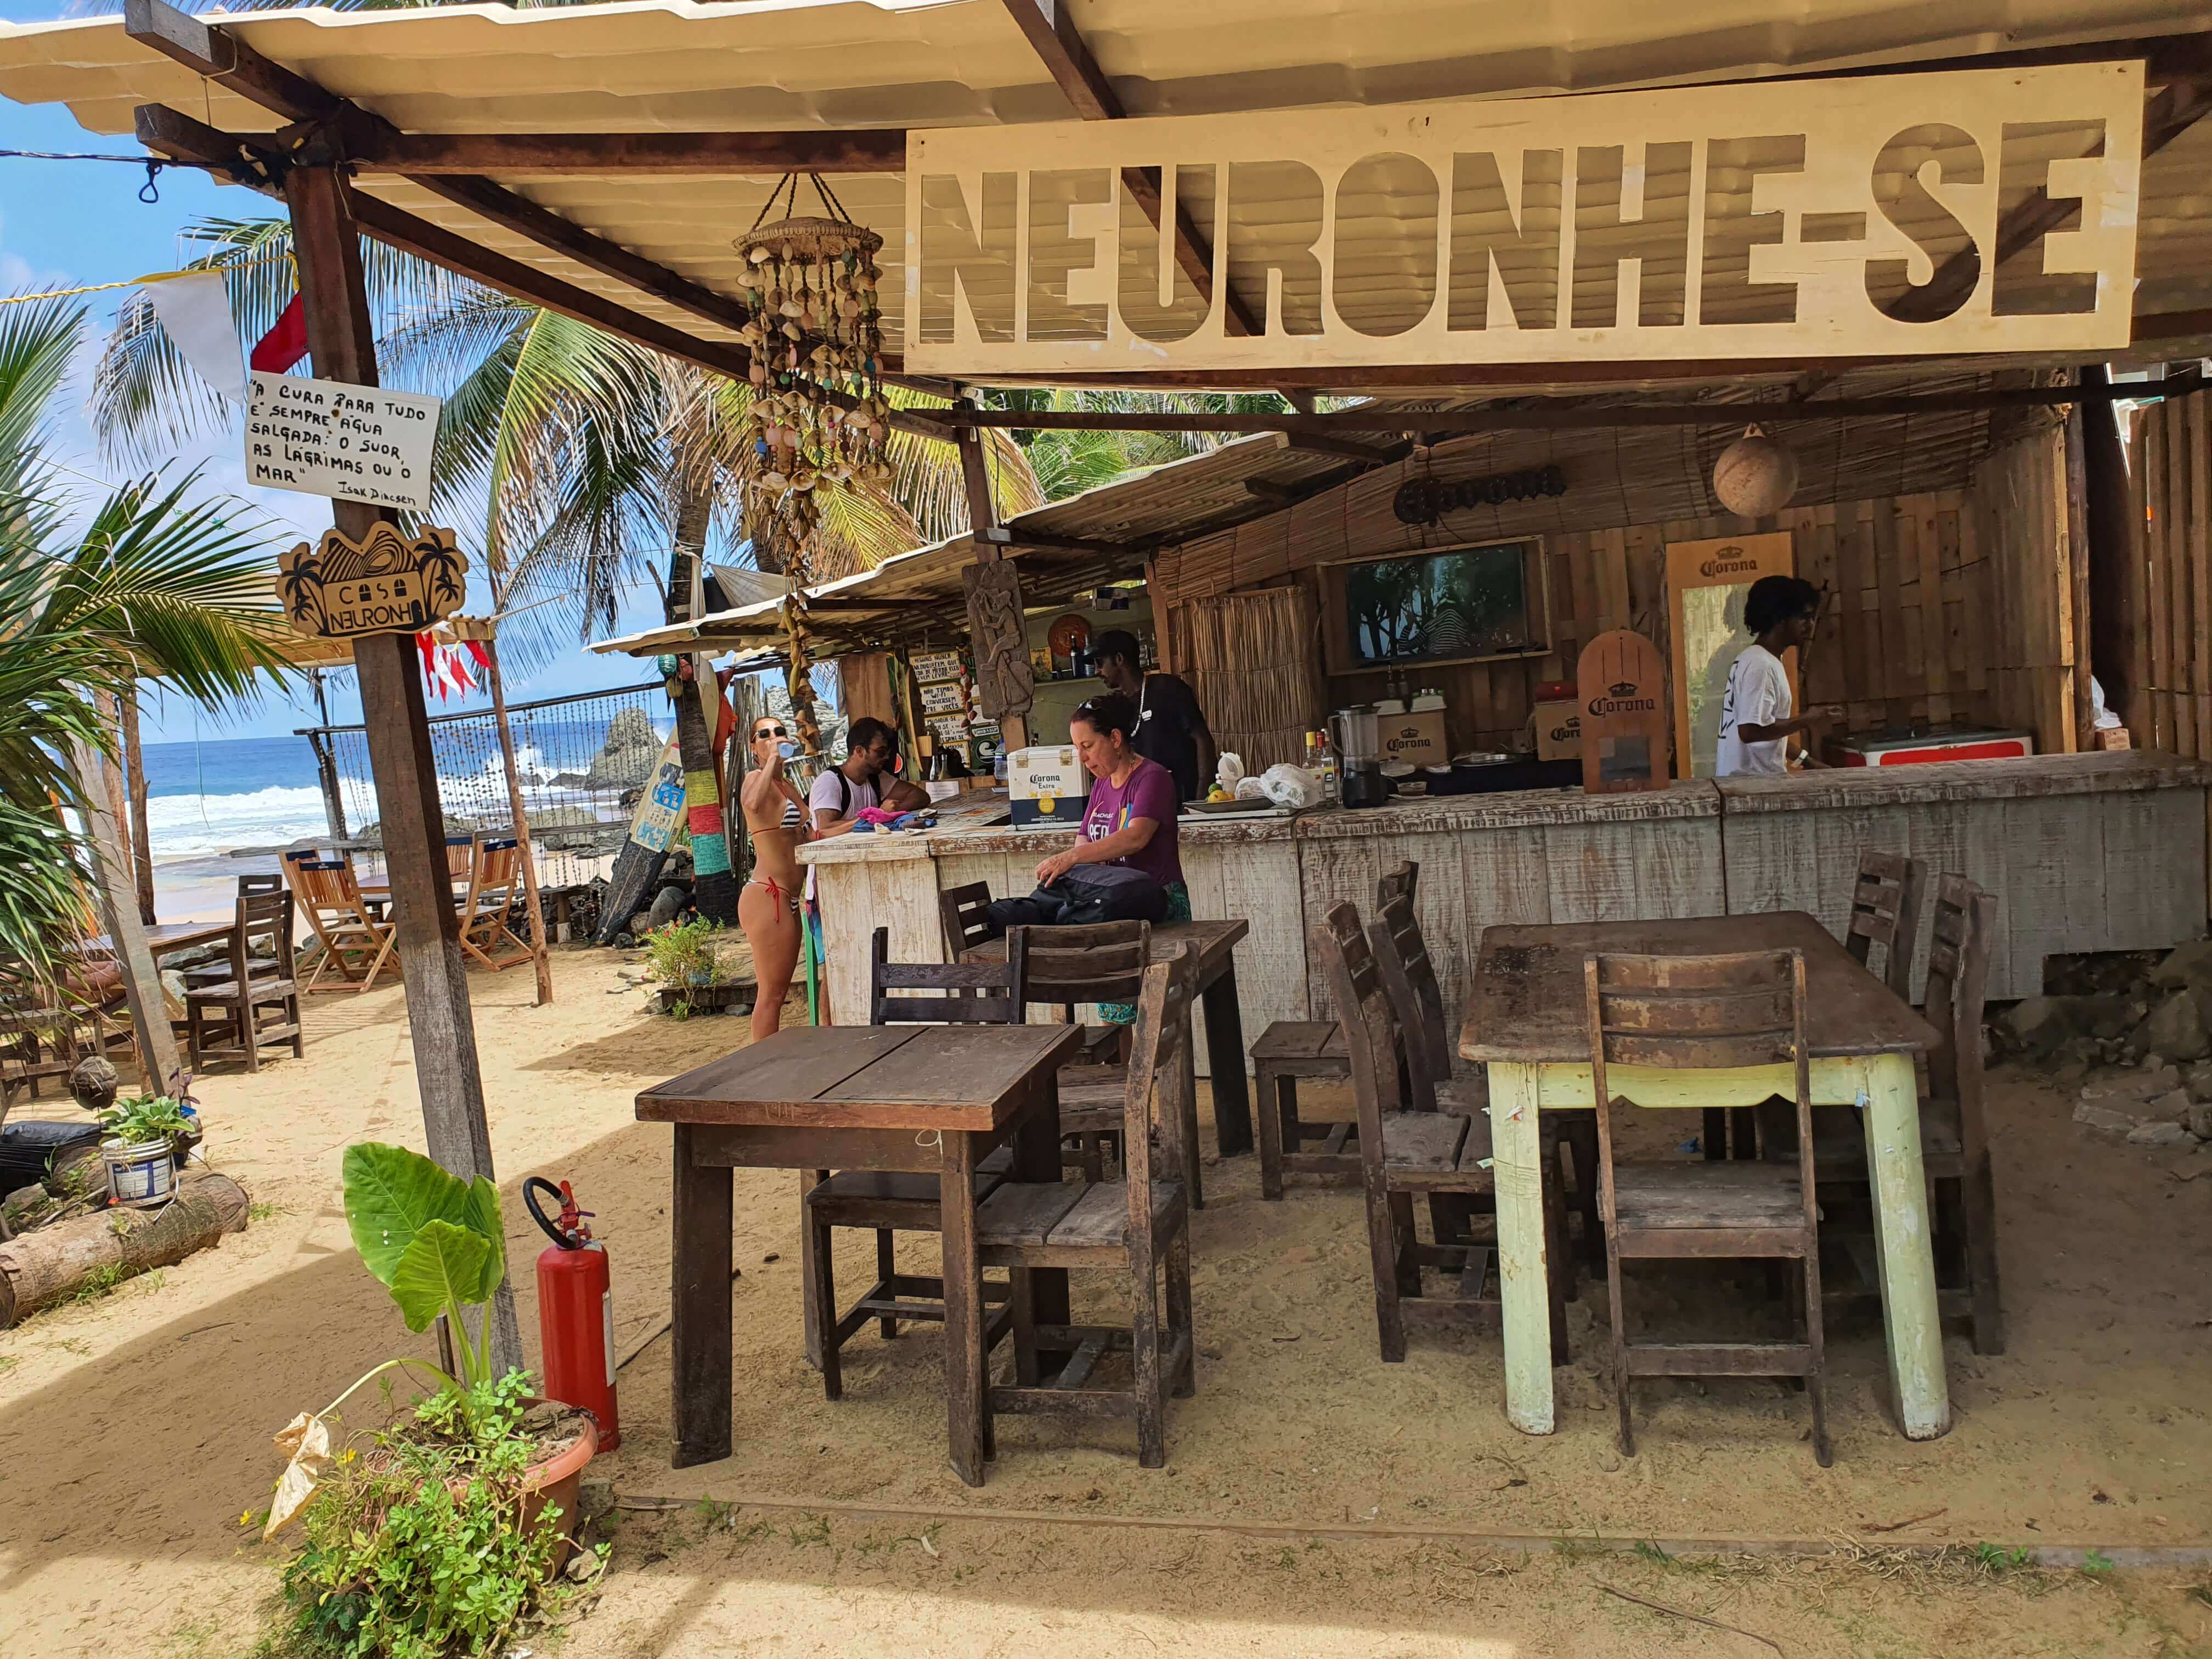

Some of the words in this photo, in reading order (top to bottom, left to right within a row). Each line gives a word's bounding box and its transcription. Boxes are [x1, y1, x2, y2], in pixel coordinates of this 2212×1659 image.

[921, 119, 2106, 343] NEURONHE-SE
[279, 385, 324, 405] CURA
[334, 393, 374, 414] PARA
[385, 403, 425, 420] TUDO
[269, 406, 330, 426] SEMPRE
[340, 415, 382, 435] ÁGUA
[250, 423, 329, 445] SALGADA:
[340, 437, 349, 449] O
[253, 444, 272, 457] AS
[373, 464, 392, 476] OU
[401, 469, 411, 478] O
[256, 464, 305, 483] MAR"
[1700, 560, 1758, 578] Corona
[1588, 697, 1656, 718] Corona
[1386, 738, 1431, 753] Corona
[1030, 774, 1060, 784] Corona
